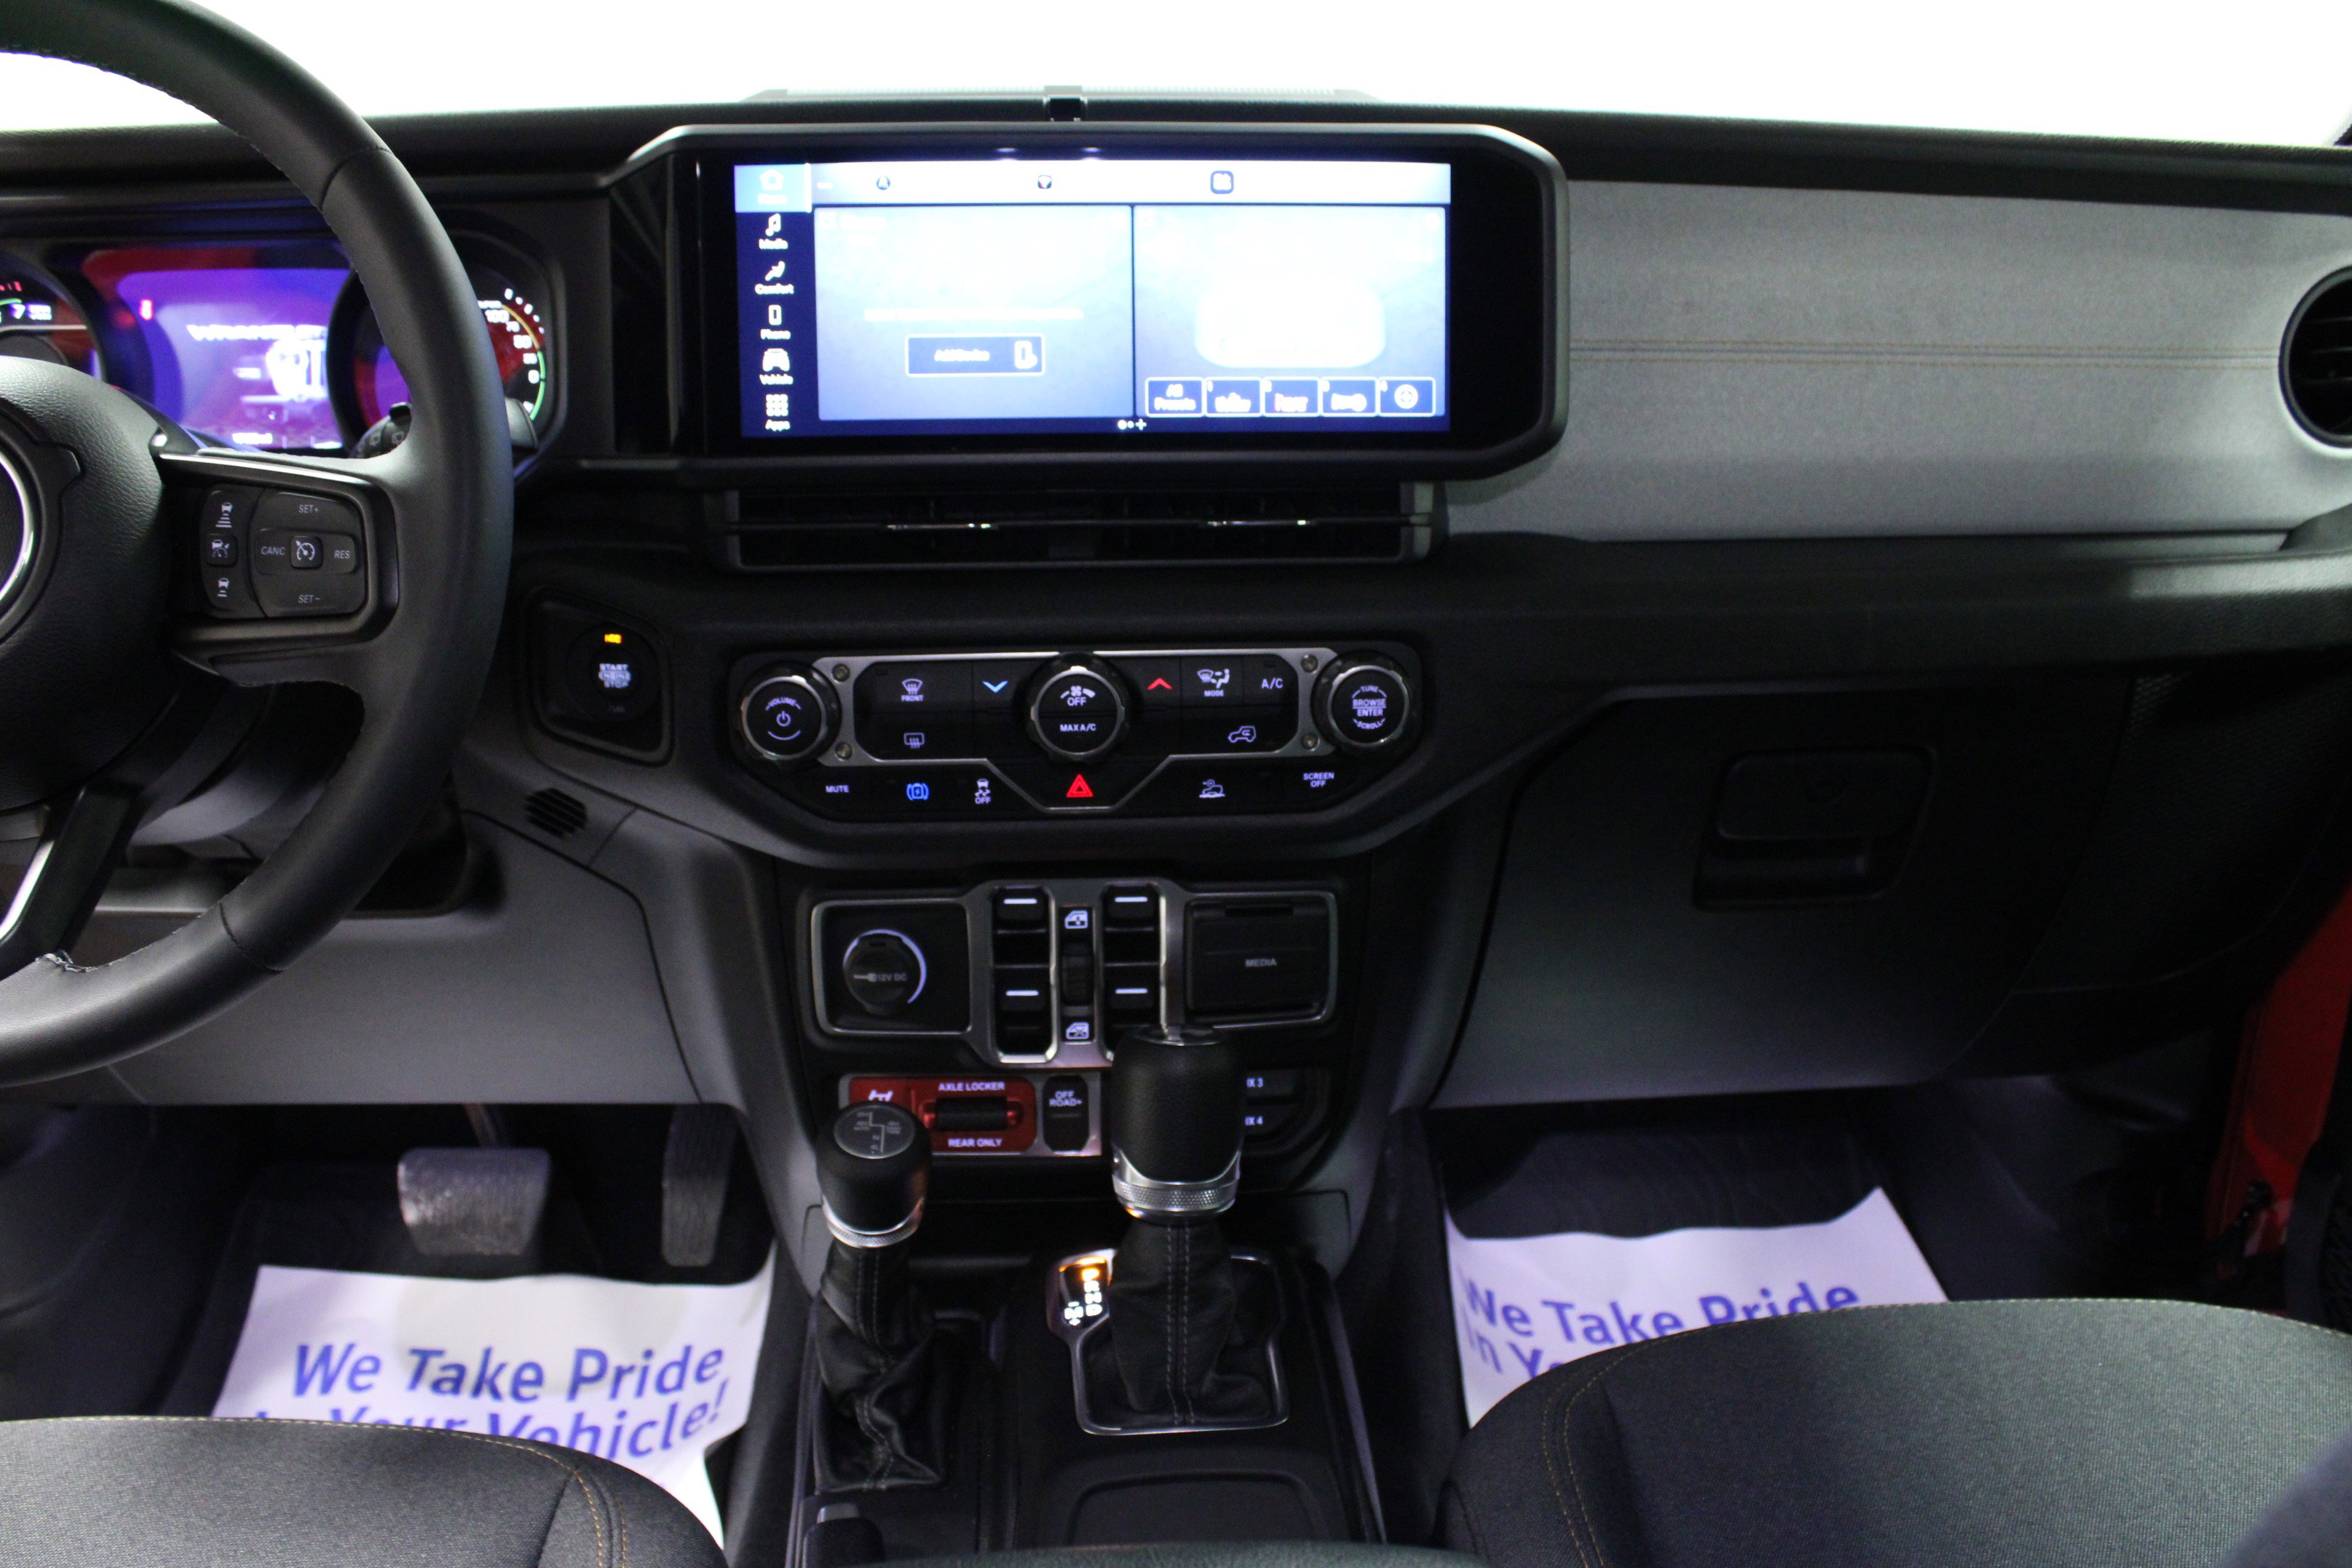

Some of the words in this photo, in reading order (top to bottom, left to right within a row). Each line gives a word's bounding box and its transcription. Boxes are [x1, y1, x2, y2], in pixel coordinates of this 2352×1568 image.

[261, 546, 286, 556] CANC
[334, 550, 351, 559] RES
[1261, 678, 1283, 689] A/C
[1361, 685, 1379, 693] TUNE
[768, 697, 797, 707] VOLUME
[1067, 697, 1086, 707] OFF
[1353, 698, 1387, 707] BROWSE
[1357, 708, 1383, 717] ENTER
[1080, 723, 1096, 731] A/C
[1357, 721, 1382, 730] SCROLL
[1303, 772, 1334, 780] SCREEN
[1245, 958, 1277, 967] MEDIA
[938, 1082, 963, 1092] AXLE
[965, 1082, 1005, 1092] LOCKER
[1055, 1090, 1074, 1099] OFF
[948, 1138, 975, 1147] REAR
[976, 1138, 1003, 1148] ONLY
[1456, 1266, 1534, 1338] We
[1540, 1300, 1684, 1345] Take
[293, 1343, 381, 1397] We
[406, 1346, 545, 1403] Take
[567, 1344, 724, 1402] Pride
